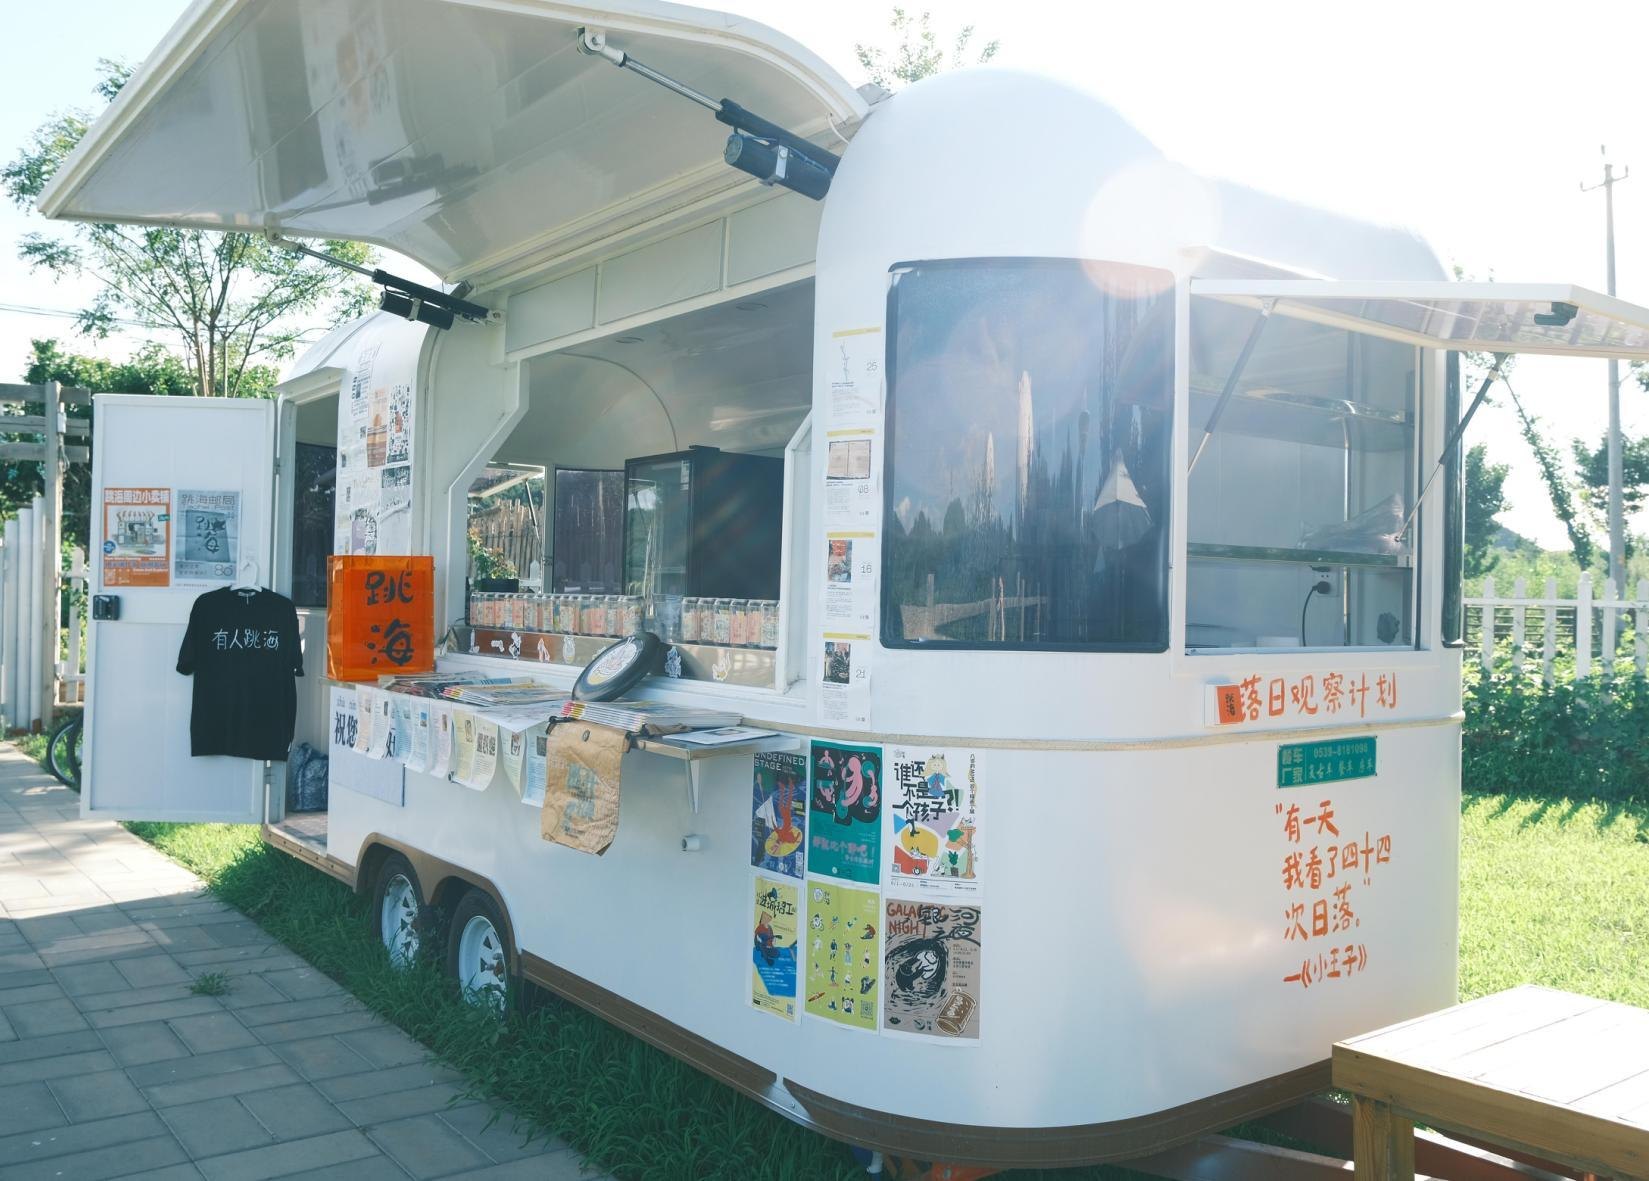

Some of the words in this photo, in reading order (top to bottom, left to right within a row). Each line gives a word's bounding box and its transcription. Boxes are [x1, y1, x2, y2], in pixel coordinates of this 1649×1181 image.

[364, 570, 415, 667] 跳海
[212, 628, 279, 650] 有人跳海
[1239, 672, 1397, 721] 落日观察计划
[754, 752, 805, 766] UNDEFINED
[754, 758, 782, 771] STAGE
[1282, 831, 1391, 890] 我看了四十四
